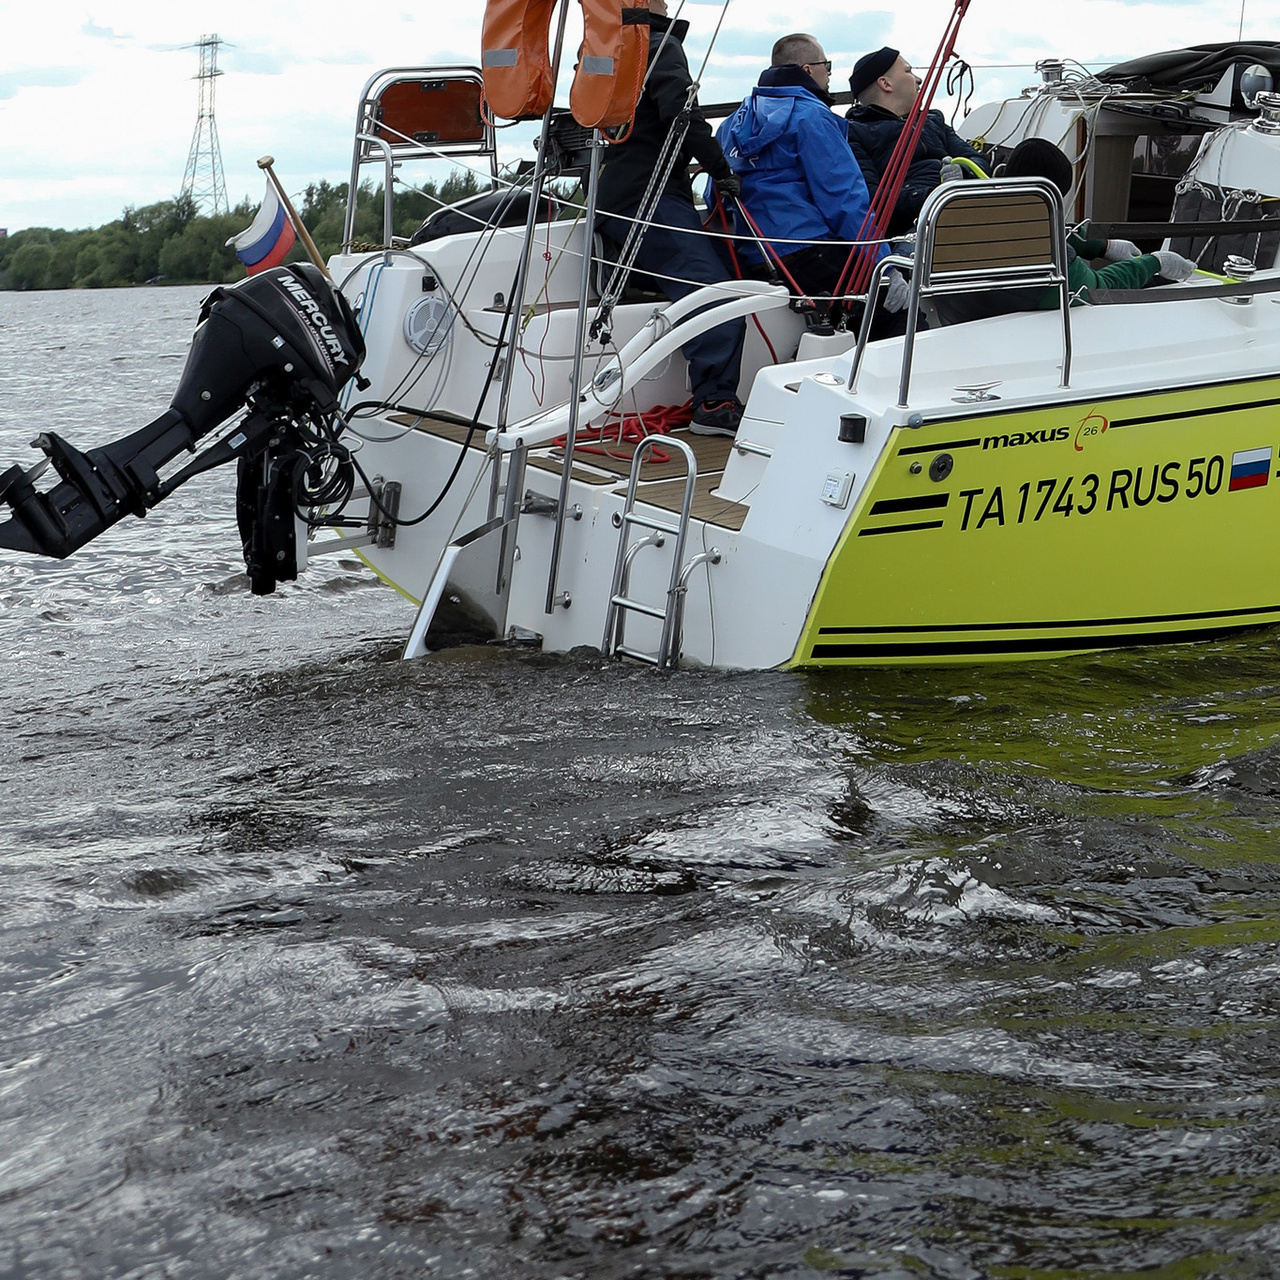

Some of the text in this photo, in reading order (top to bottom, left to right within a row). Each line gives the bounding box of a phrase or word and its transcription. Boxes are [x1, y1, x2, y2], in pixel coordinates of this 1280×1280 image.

[277, 275, 349, 366] MERCURY
[982, 426, 1098, 450] maxus 26
[959, 486, 1005, 531] TA
[1017, 473, 1100, 524] 1743
